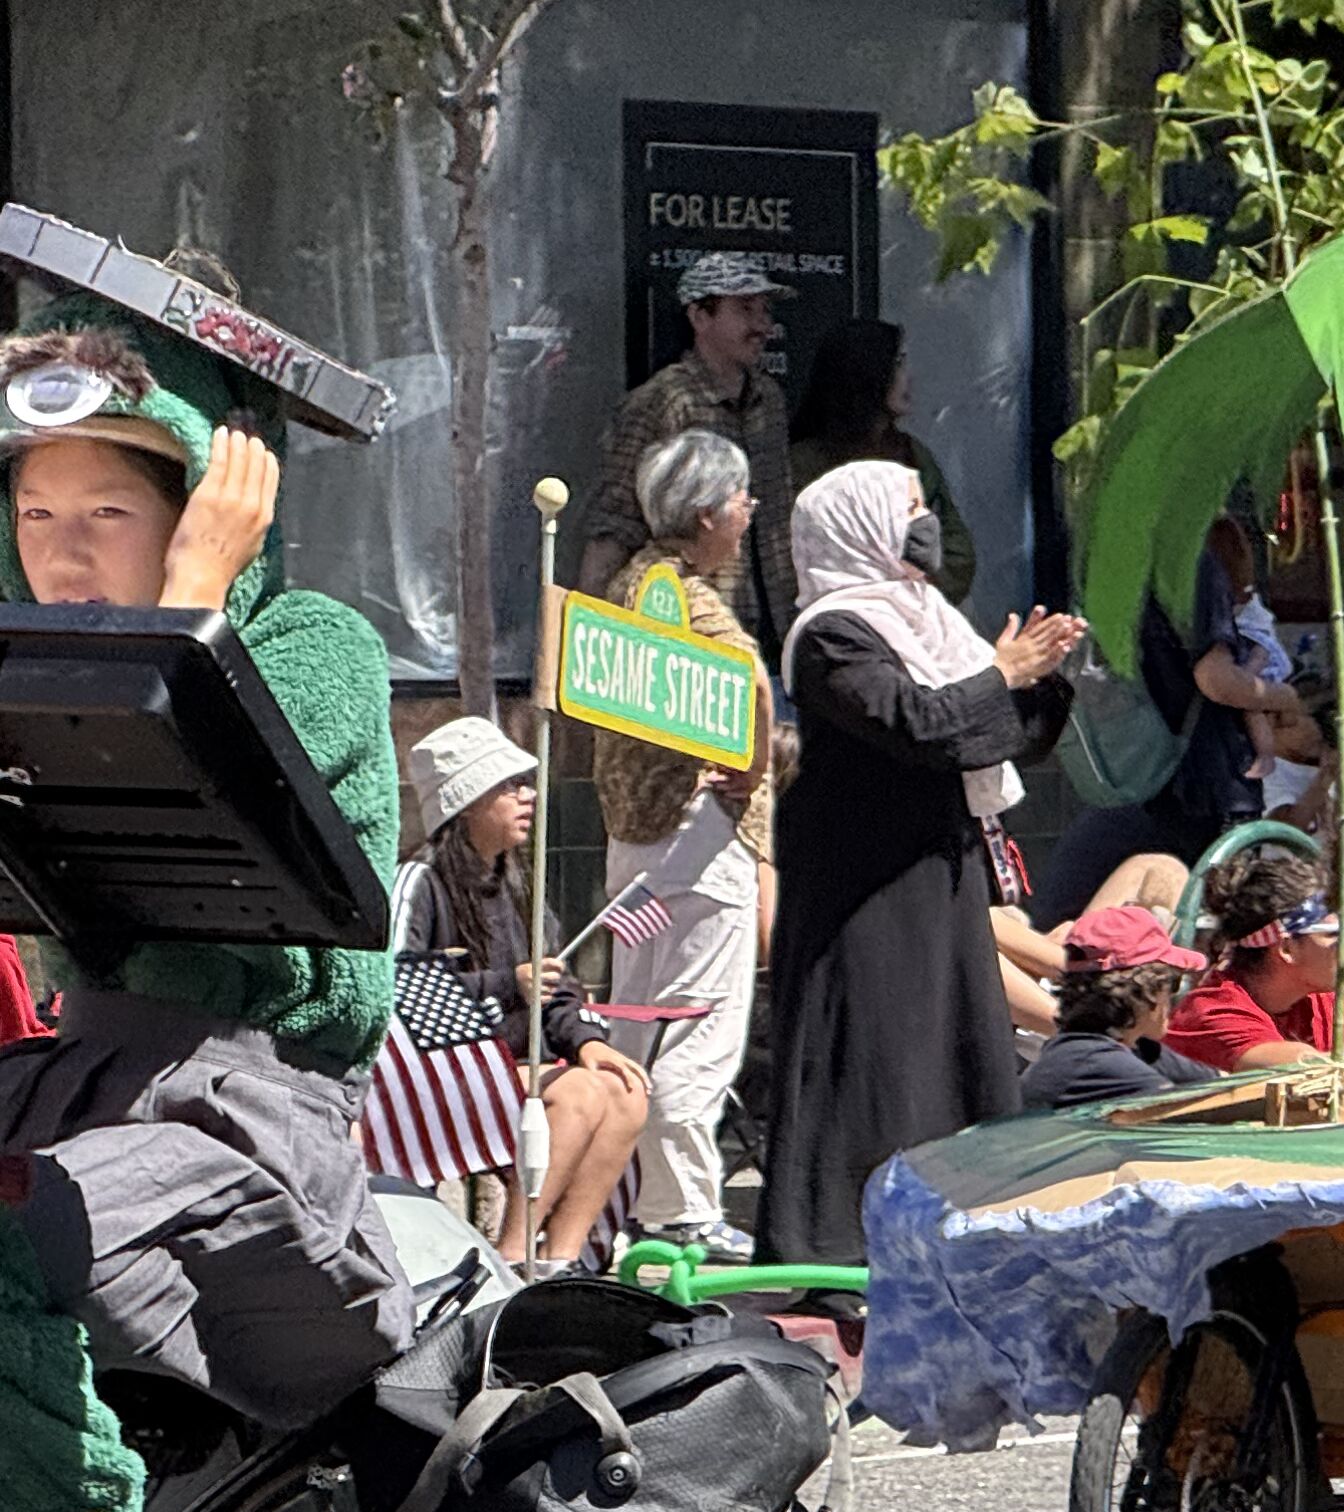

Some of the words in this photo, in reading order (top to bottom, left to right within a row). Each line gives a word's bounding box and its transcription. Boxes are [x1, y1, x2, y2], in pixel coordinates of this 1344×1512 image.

[650, 192, 704, 228] FOR
[713, 196, 792, 232] LEASE
[571, 622, 660, 713] SESAME
[664, 652, 746, 741] STREET
